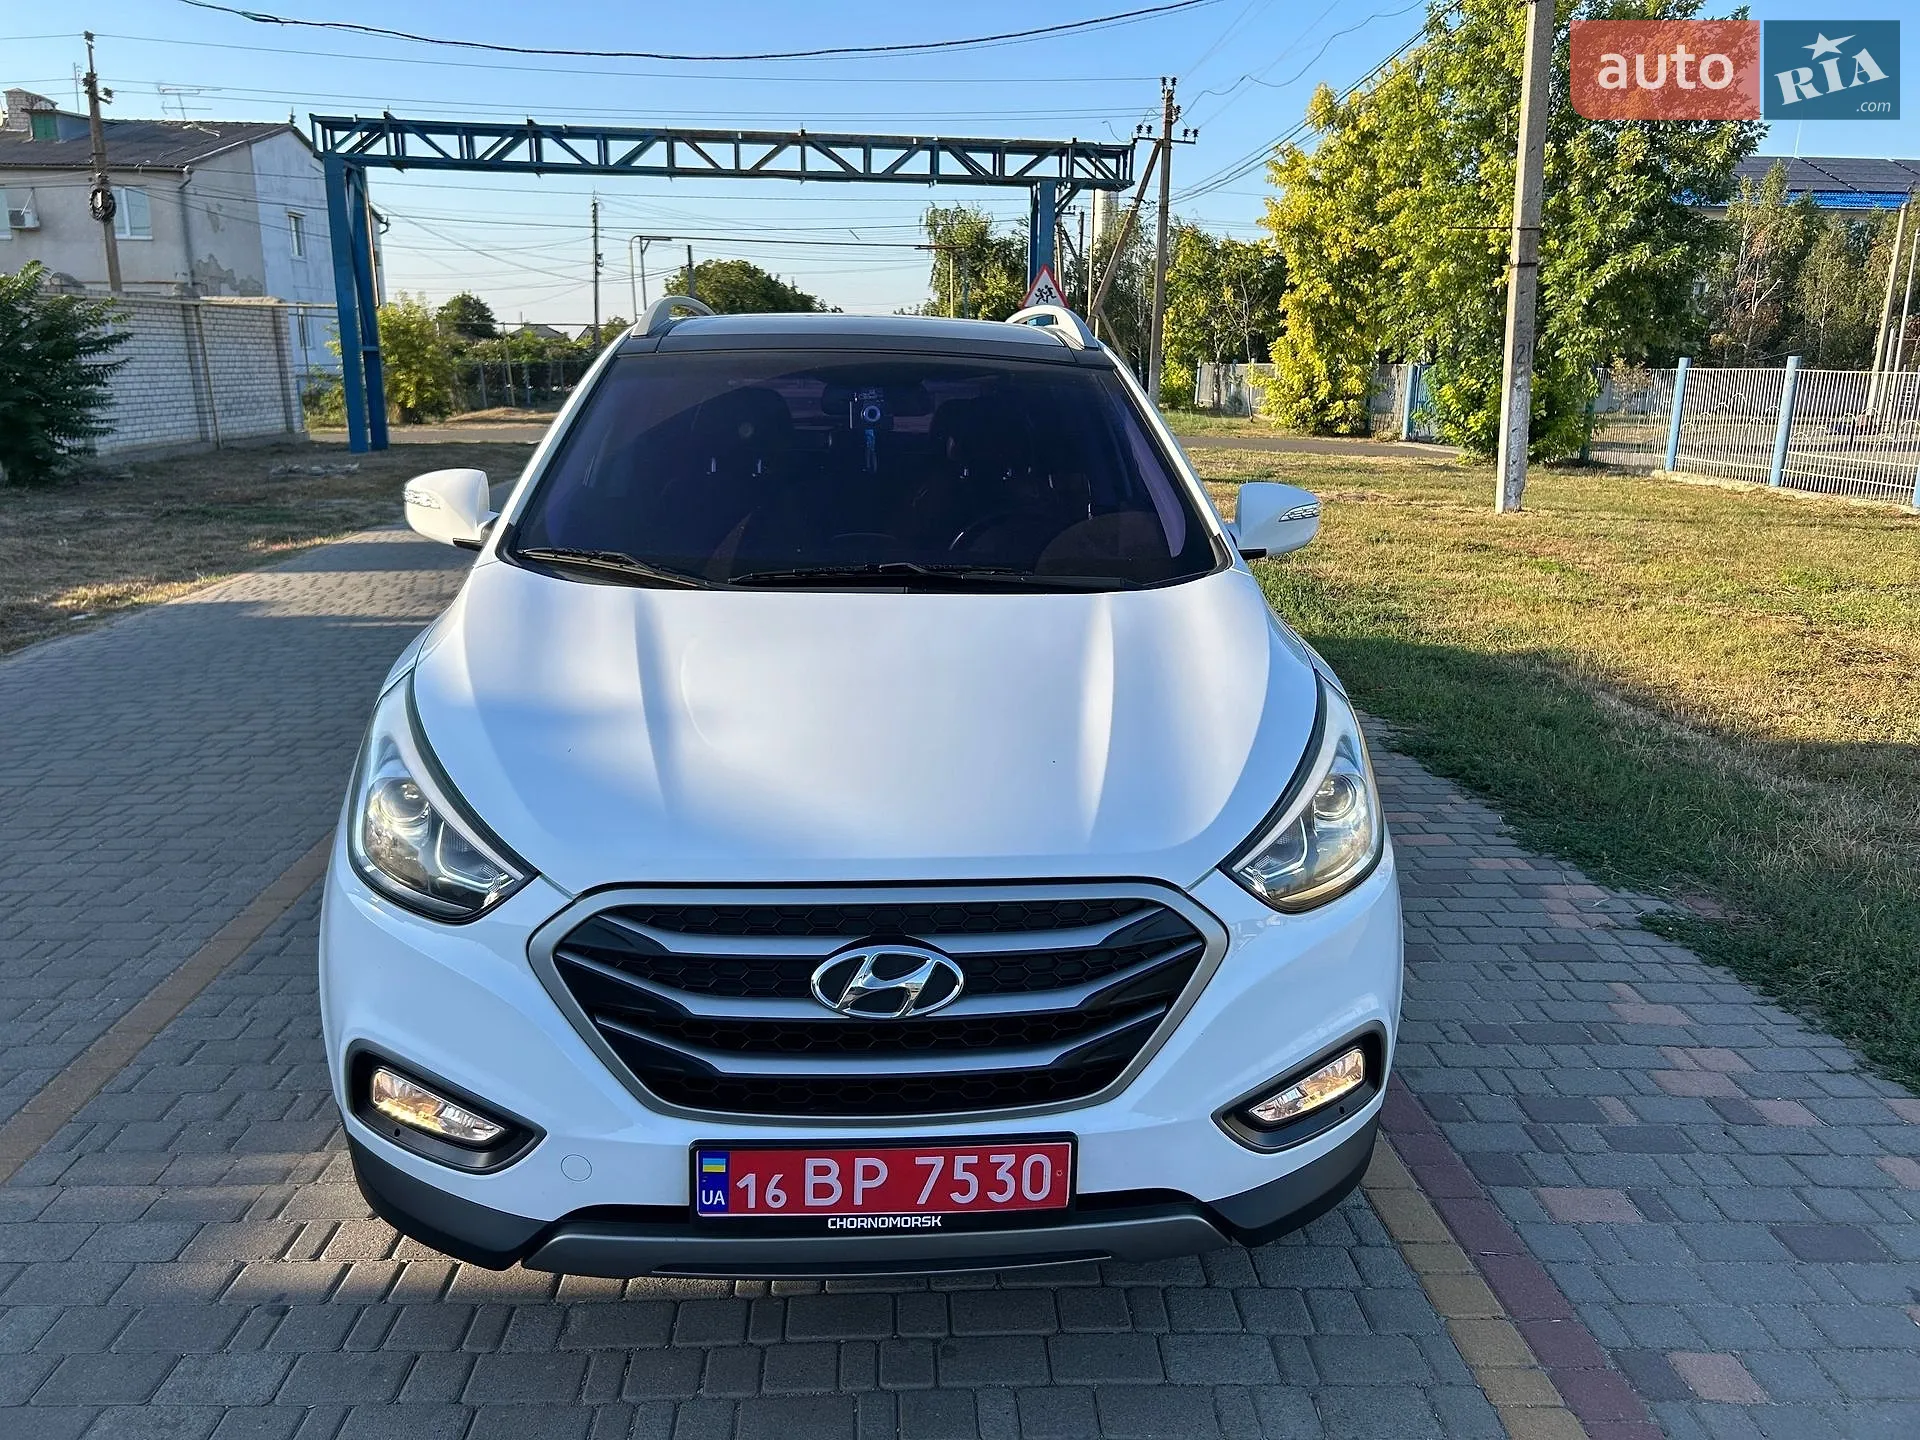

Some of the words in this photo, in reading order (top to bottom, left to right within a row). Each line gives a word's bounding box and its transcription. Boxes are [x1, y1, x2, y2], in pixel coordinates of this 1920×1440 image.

[736, 1173, 787, 1209] 16
[805, 1157, 889, 1207] BP
[914, 1154, 1052, 1205] 7530
[702, 1189, 726, 1206] UA
[827, 1215, 942, 1230] CHORNOMORSK
